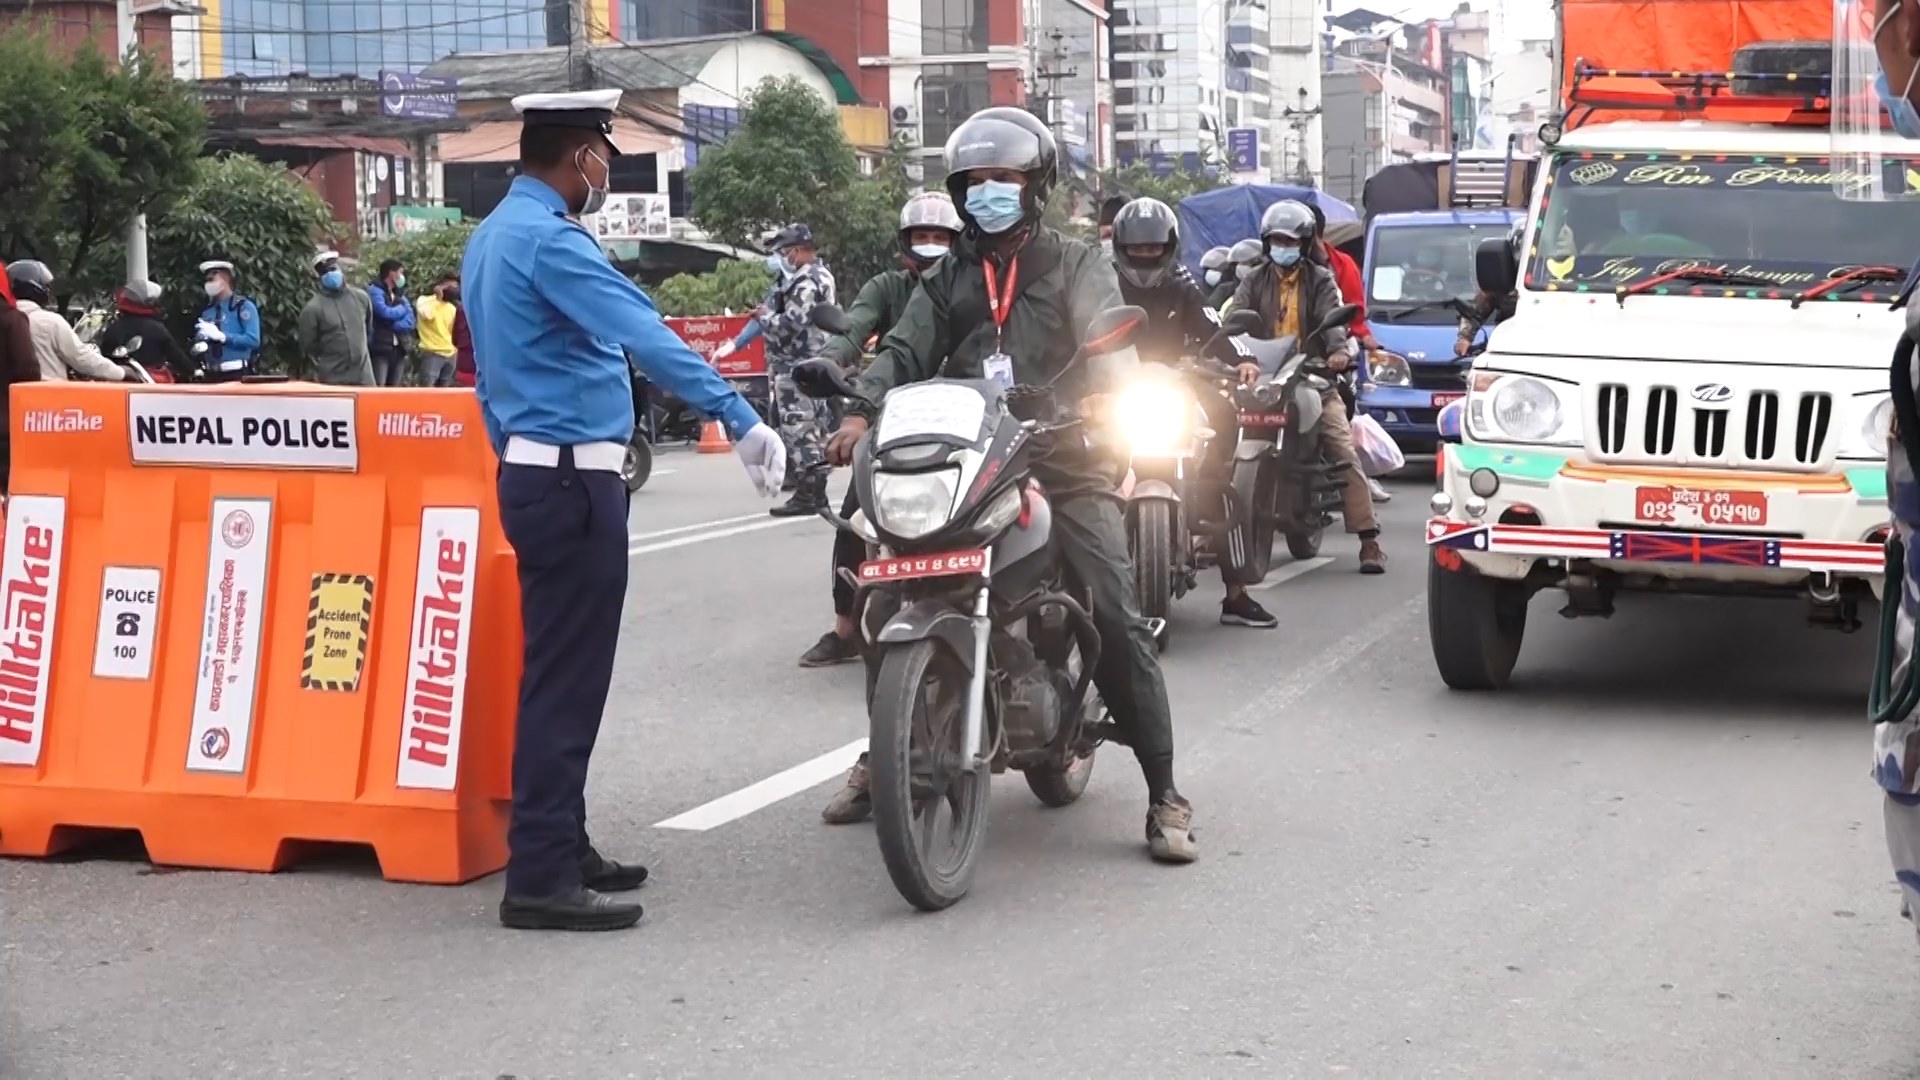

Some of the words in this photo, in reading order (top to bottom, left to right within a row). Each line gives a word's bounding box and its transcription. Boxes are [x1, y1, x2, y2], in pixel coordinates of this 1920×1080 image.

[24, 409, 103, 432] Hilltake
[378, 412, 464, 438] Hilltake
[136, 415, 233, 444] NEPAL
[242, 417, 350, 449] POLICE
[105, 588, 156, 604] POLICE
[318, 608, 361, 622] Accident
[0, 525, 53, 744] Hilltake
[323, 627, 351, 640] Prone
[113, 645, 137, 660] 100
[323, 645, 348, 659] Zone
[407, 539, 467, 767] Hilltake
